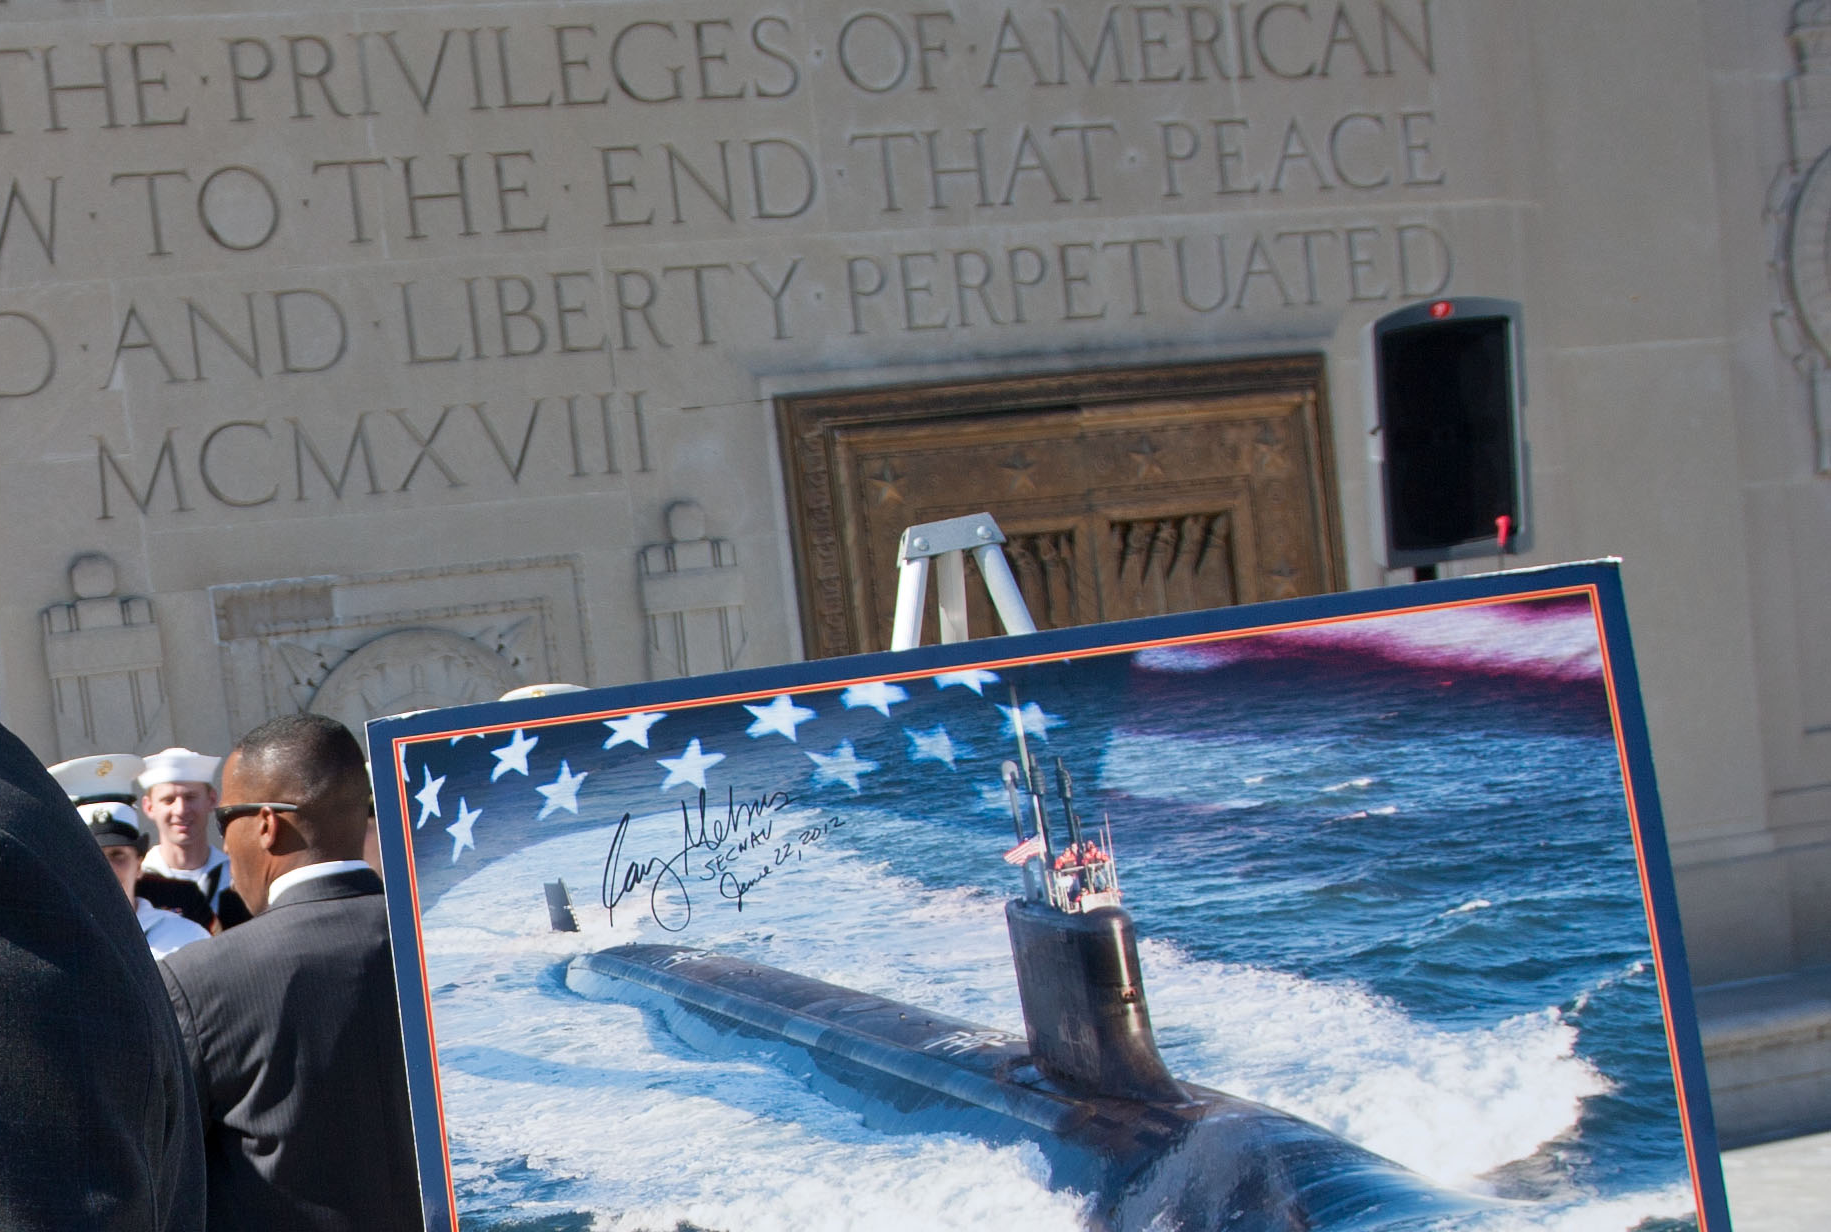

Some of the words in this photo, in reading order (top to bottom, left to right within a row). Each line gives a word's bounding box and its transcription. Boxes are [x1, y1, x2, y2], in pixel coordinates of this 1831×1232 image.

[221, 16, 800, 123] PRIVILEGES
[838, 10, 958, 93] OF
[984, 1, 1436, 89] AMERICAN
[111, 165, 280, 257] TO
[312, 150, 550, 245] THE
[596, 138, 819, 227] END
[849, 123, 1116, 212] THAT
[1156, 111, 1447, 198] PEACE
[101, 290, 347, 389] AND
[391, 257, 803, 364] LIBERTY
[843, 224, 1452, 336] PERPETUATED
[91, 389, 654, 521] MCMXVIII
[799, 816, 846, 846] 2012
